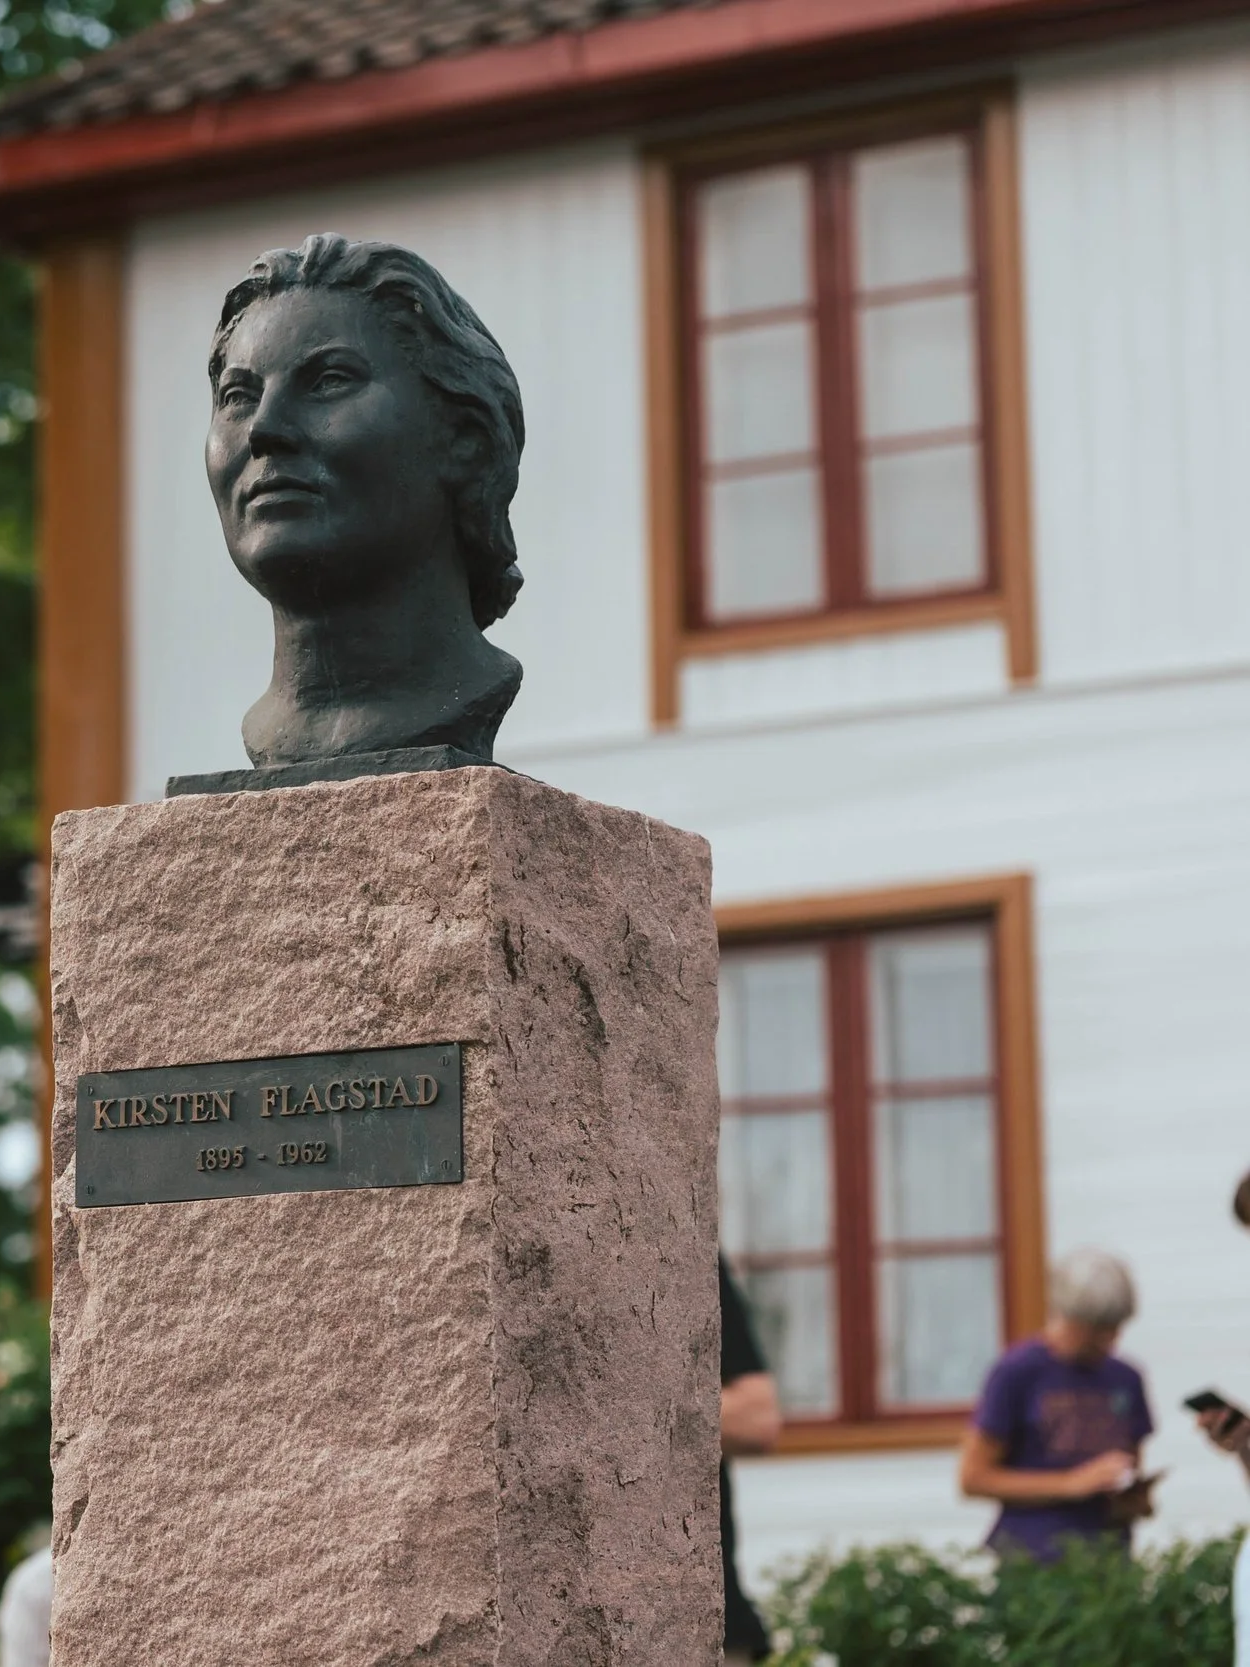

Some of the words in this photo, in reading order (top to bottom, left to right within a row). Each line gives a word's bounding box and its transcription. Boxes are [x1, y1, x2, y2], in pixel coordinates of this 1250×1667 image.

[93, 1089, 234, 1131] KIRSTEN
[260, 1074, 440, 1118] FLAGSTAD
[196, 1145, 246, 1172] 1895
[276, 1141, 327, 1167] 1962
